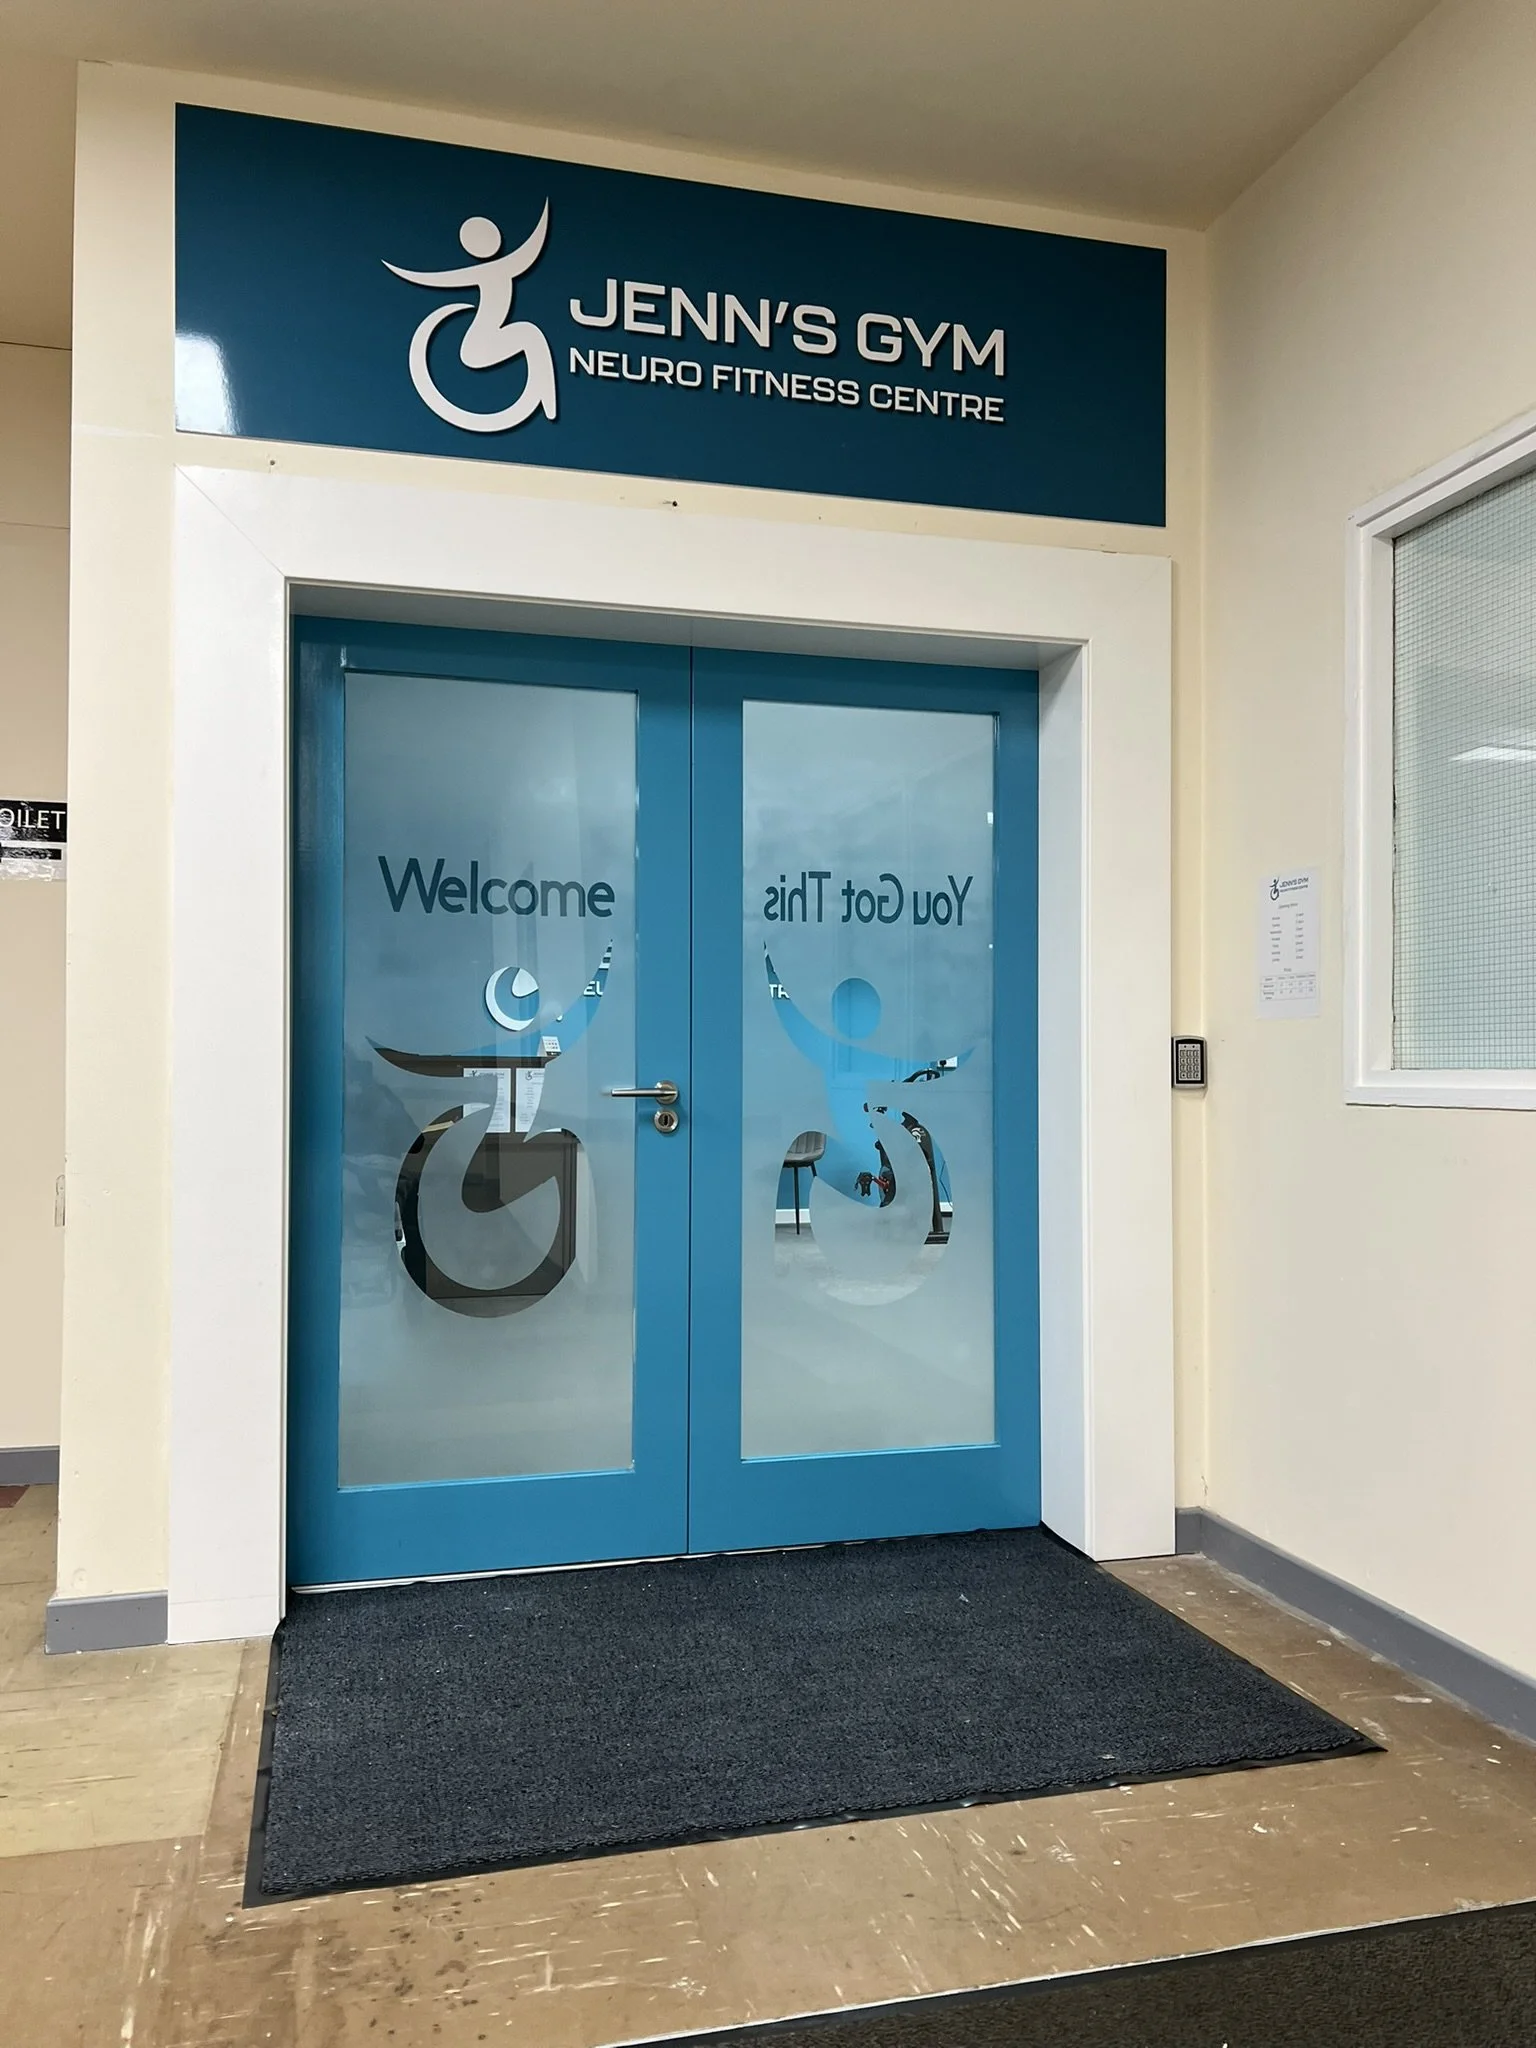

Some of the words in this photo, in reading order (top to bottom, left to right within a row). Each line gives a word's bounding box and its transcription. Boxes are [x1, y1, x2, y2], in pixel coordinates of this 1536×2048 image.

[570, 278, 837, 355] JENN'S
[857, 312, 1005, 377] GYM
[569, 347, 702, 388] NEURO
[712, 364, 860, 406] FITNESS
[869, 383, 1005, 423] CENTRE
[0, 808, 66, 830] OILET
[377, 855, 616, 918] Welcome
